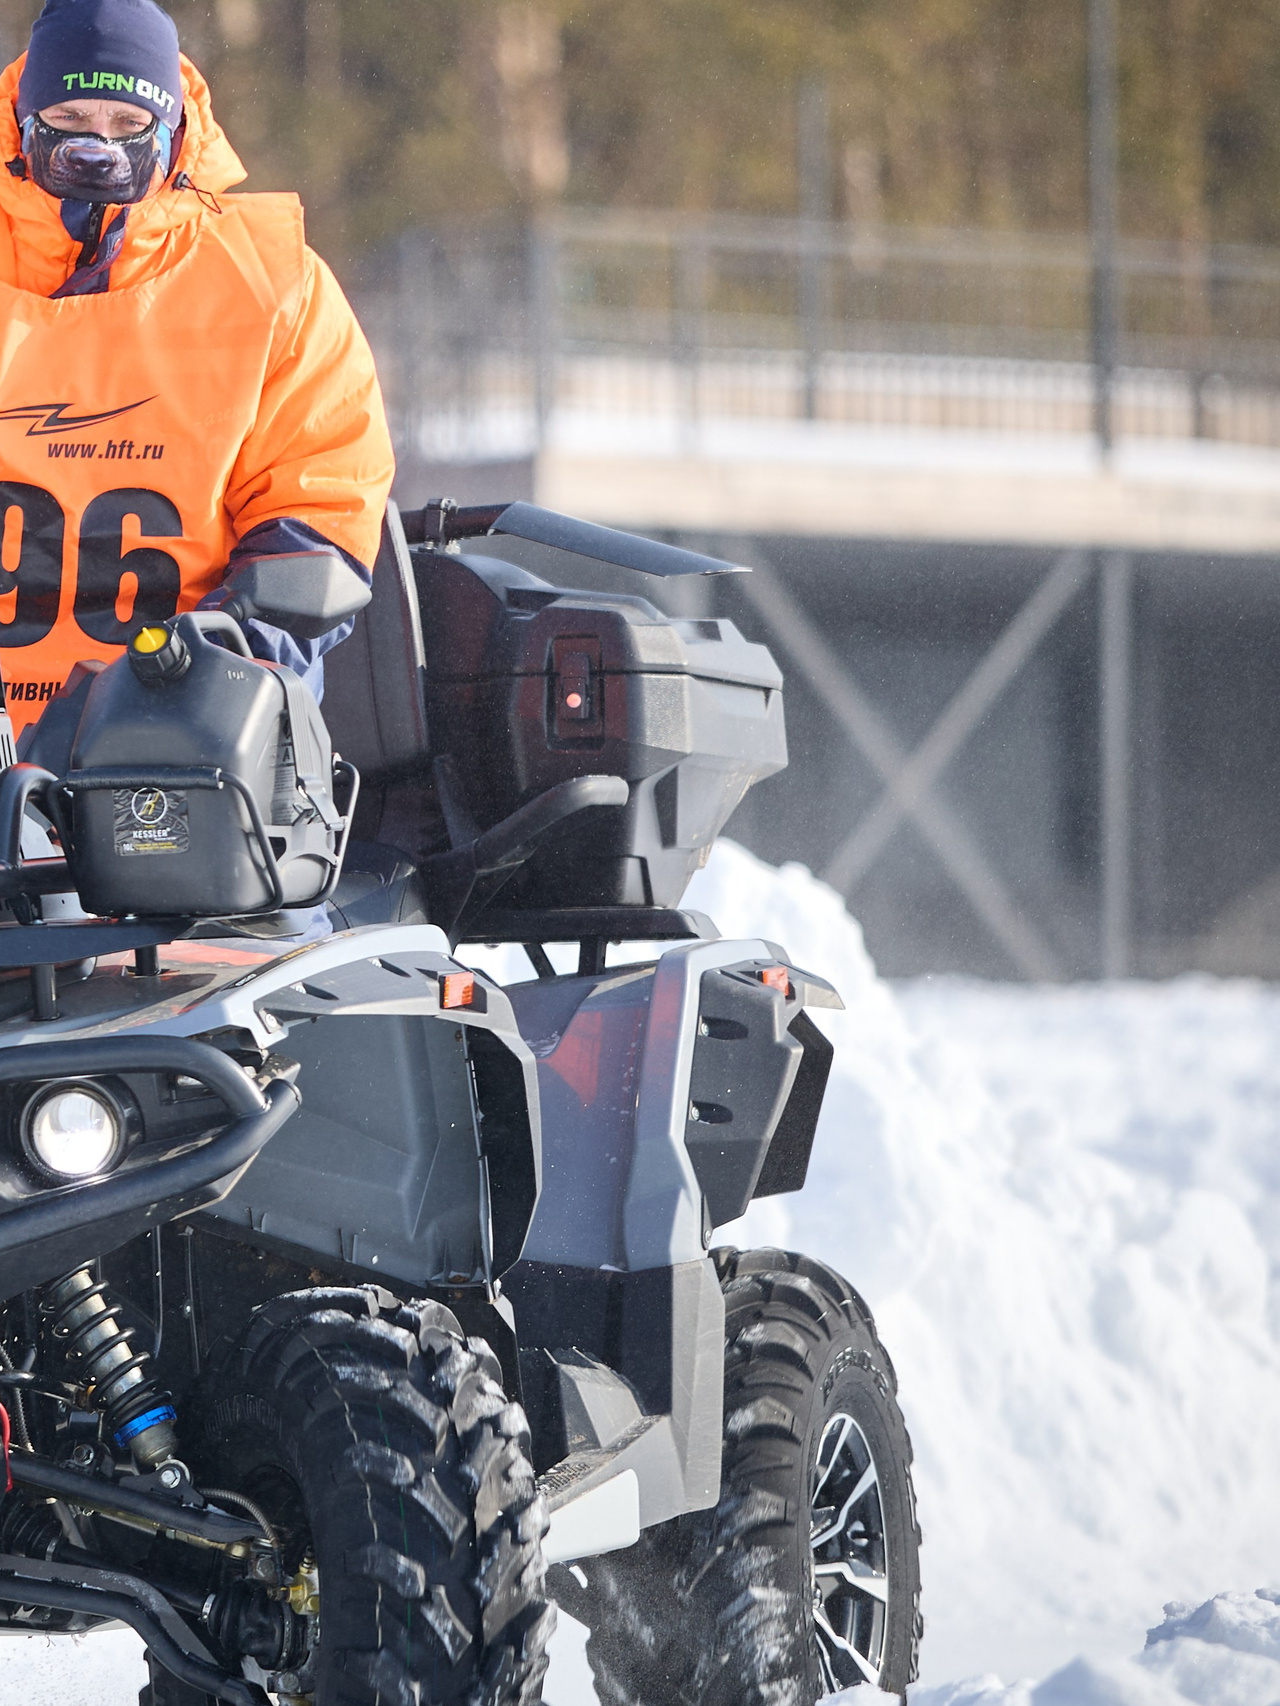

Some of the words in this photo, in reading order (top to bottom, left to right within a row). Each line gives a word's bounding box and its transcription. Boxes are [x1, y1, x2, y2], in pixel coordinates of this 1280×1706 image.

[62, 71, 176, 114] TURNOUT
[47, 440, 164, 460] www.hft.ru
[132, 829, 169, 839] KESSLER
